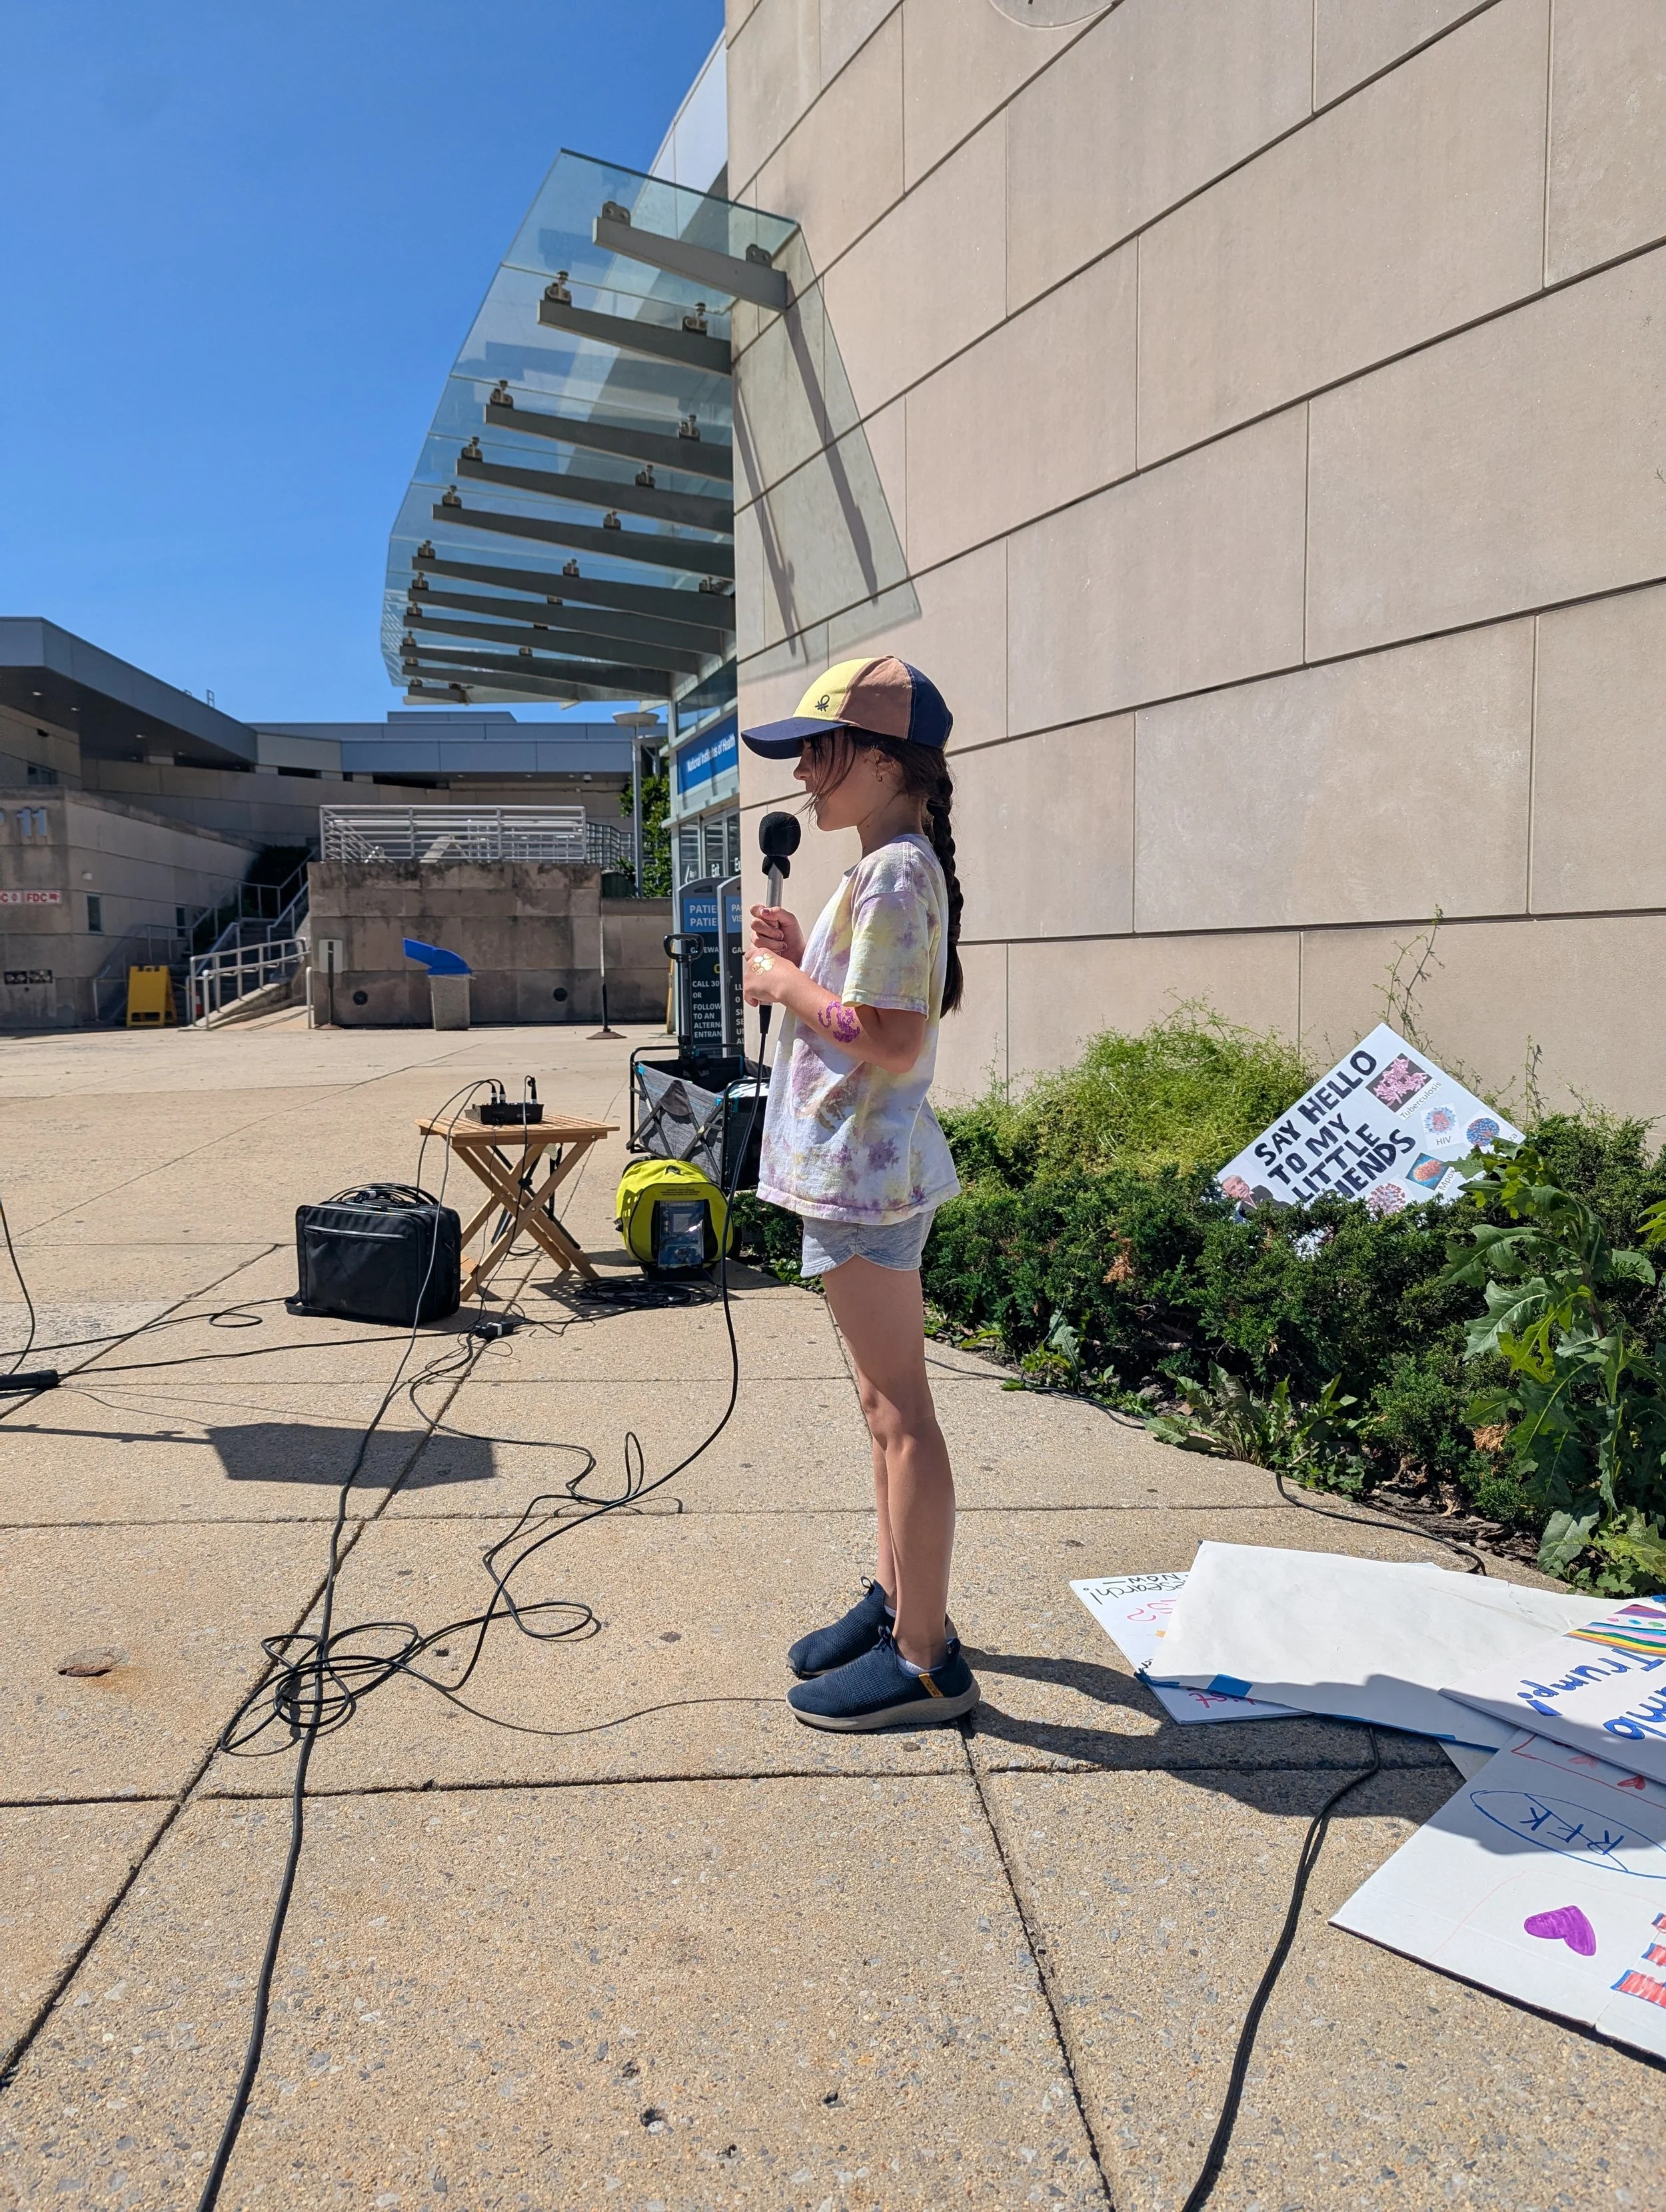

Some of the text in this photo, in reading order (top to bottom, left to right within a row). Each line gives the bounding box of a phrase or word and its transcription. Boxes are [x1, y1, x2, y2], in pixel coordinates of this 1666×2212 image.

[722, 733, 736, 753] Health
[17, 808, 47, 836] 11
[27, 893, 47, 902] FDC
[690, 905, 717, 914] PATIE
[690, 917, 718, 927] PATIE
[1254, 1050, 1377, 1166] SAY HELLO
[1399, 1081, 1441, 1119] Tuberculosis
[1267, 1113, 1350, 1185] TO MY
[1436, 1135, 1451, 1146] HIV
[1291, 1123, 1381, 1203] LITTLE
[1333, 1129, 1416, 1200] IENDS
[1438, 1168, 1456, 1191] Mpox
[1083, 1580, 1186, 1605] esearch!
[1517, 1648, 1666, 1716] Trump!
[1519, 1806, 1624, 1855] RFK
